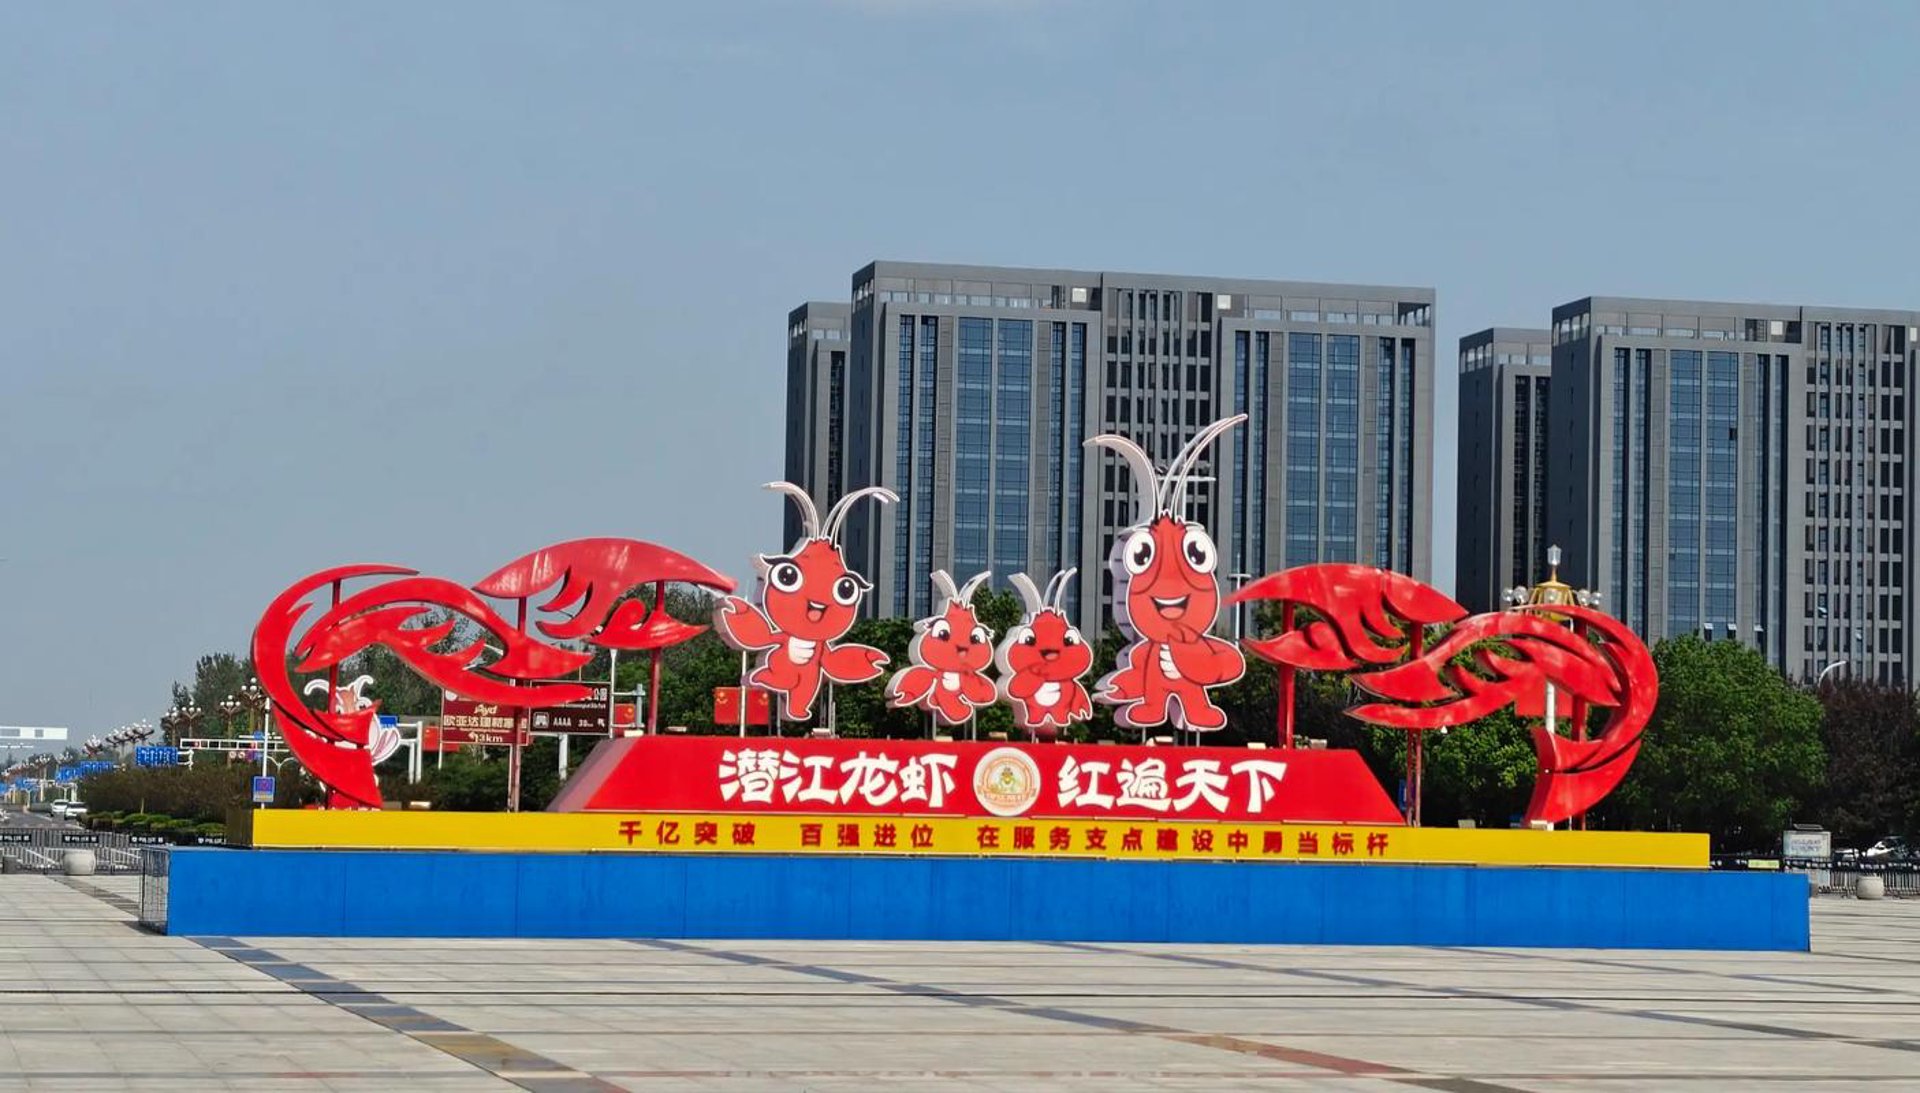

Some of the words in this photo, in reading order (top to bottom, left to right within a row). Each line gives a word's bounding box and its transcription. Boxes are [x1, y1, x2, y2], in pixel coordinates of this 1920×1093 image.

[719, 748, 958, 807] 潜江龙虾
[1057, 755, 1287, 813] 红遍天下
[618, 820, 756, 845] 千亿突破
[800, 823, 934, 848] 百强进位
[976, 825, 1389, 856] 在服务支点建设中勇当标杆
